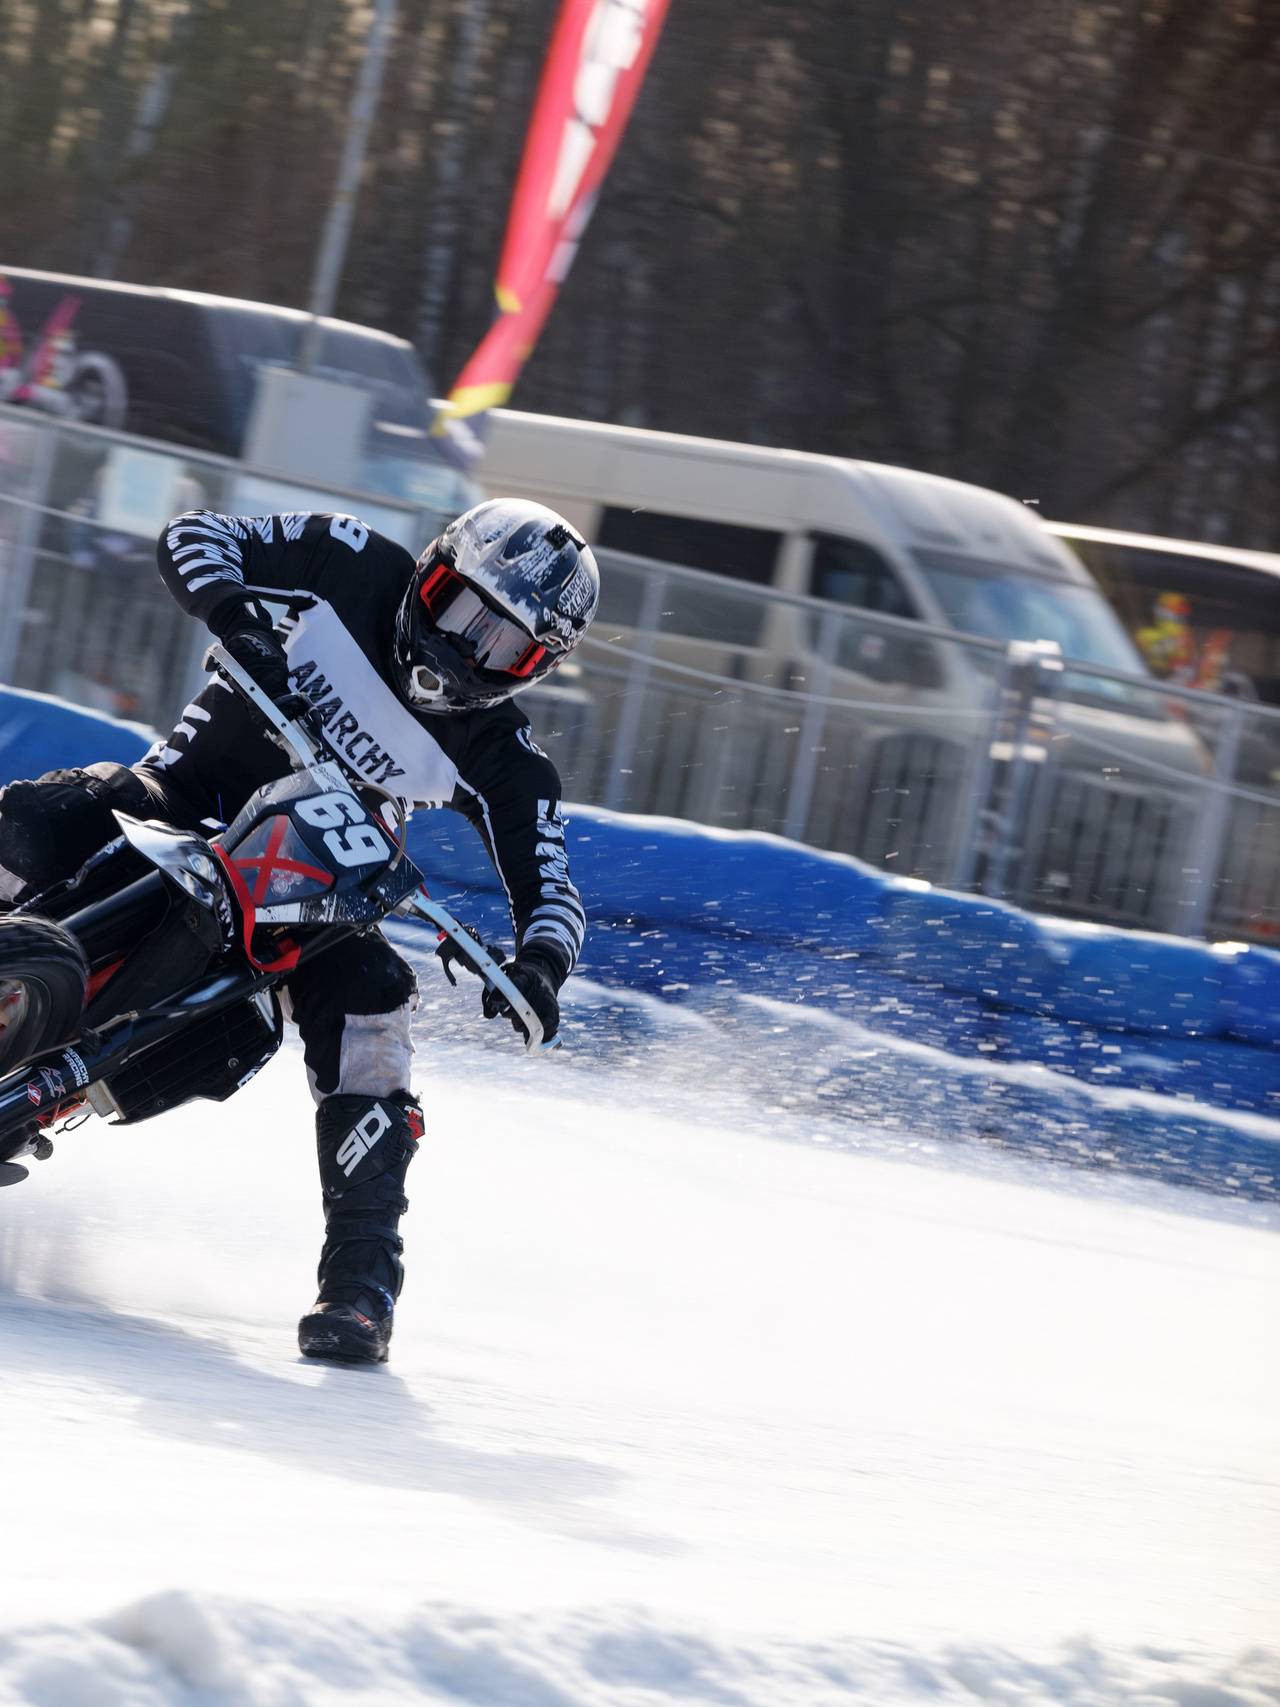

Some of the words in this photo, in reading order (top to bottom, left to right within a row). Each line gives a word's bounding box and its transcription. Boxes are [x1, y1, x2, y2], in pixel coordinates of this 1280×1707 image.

[289, 660, 406, 784] ANARCHY
[294, 791, 391, 868] 69
[336, 1102, 392, 1178] SIDI
